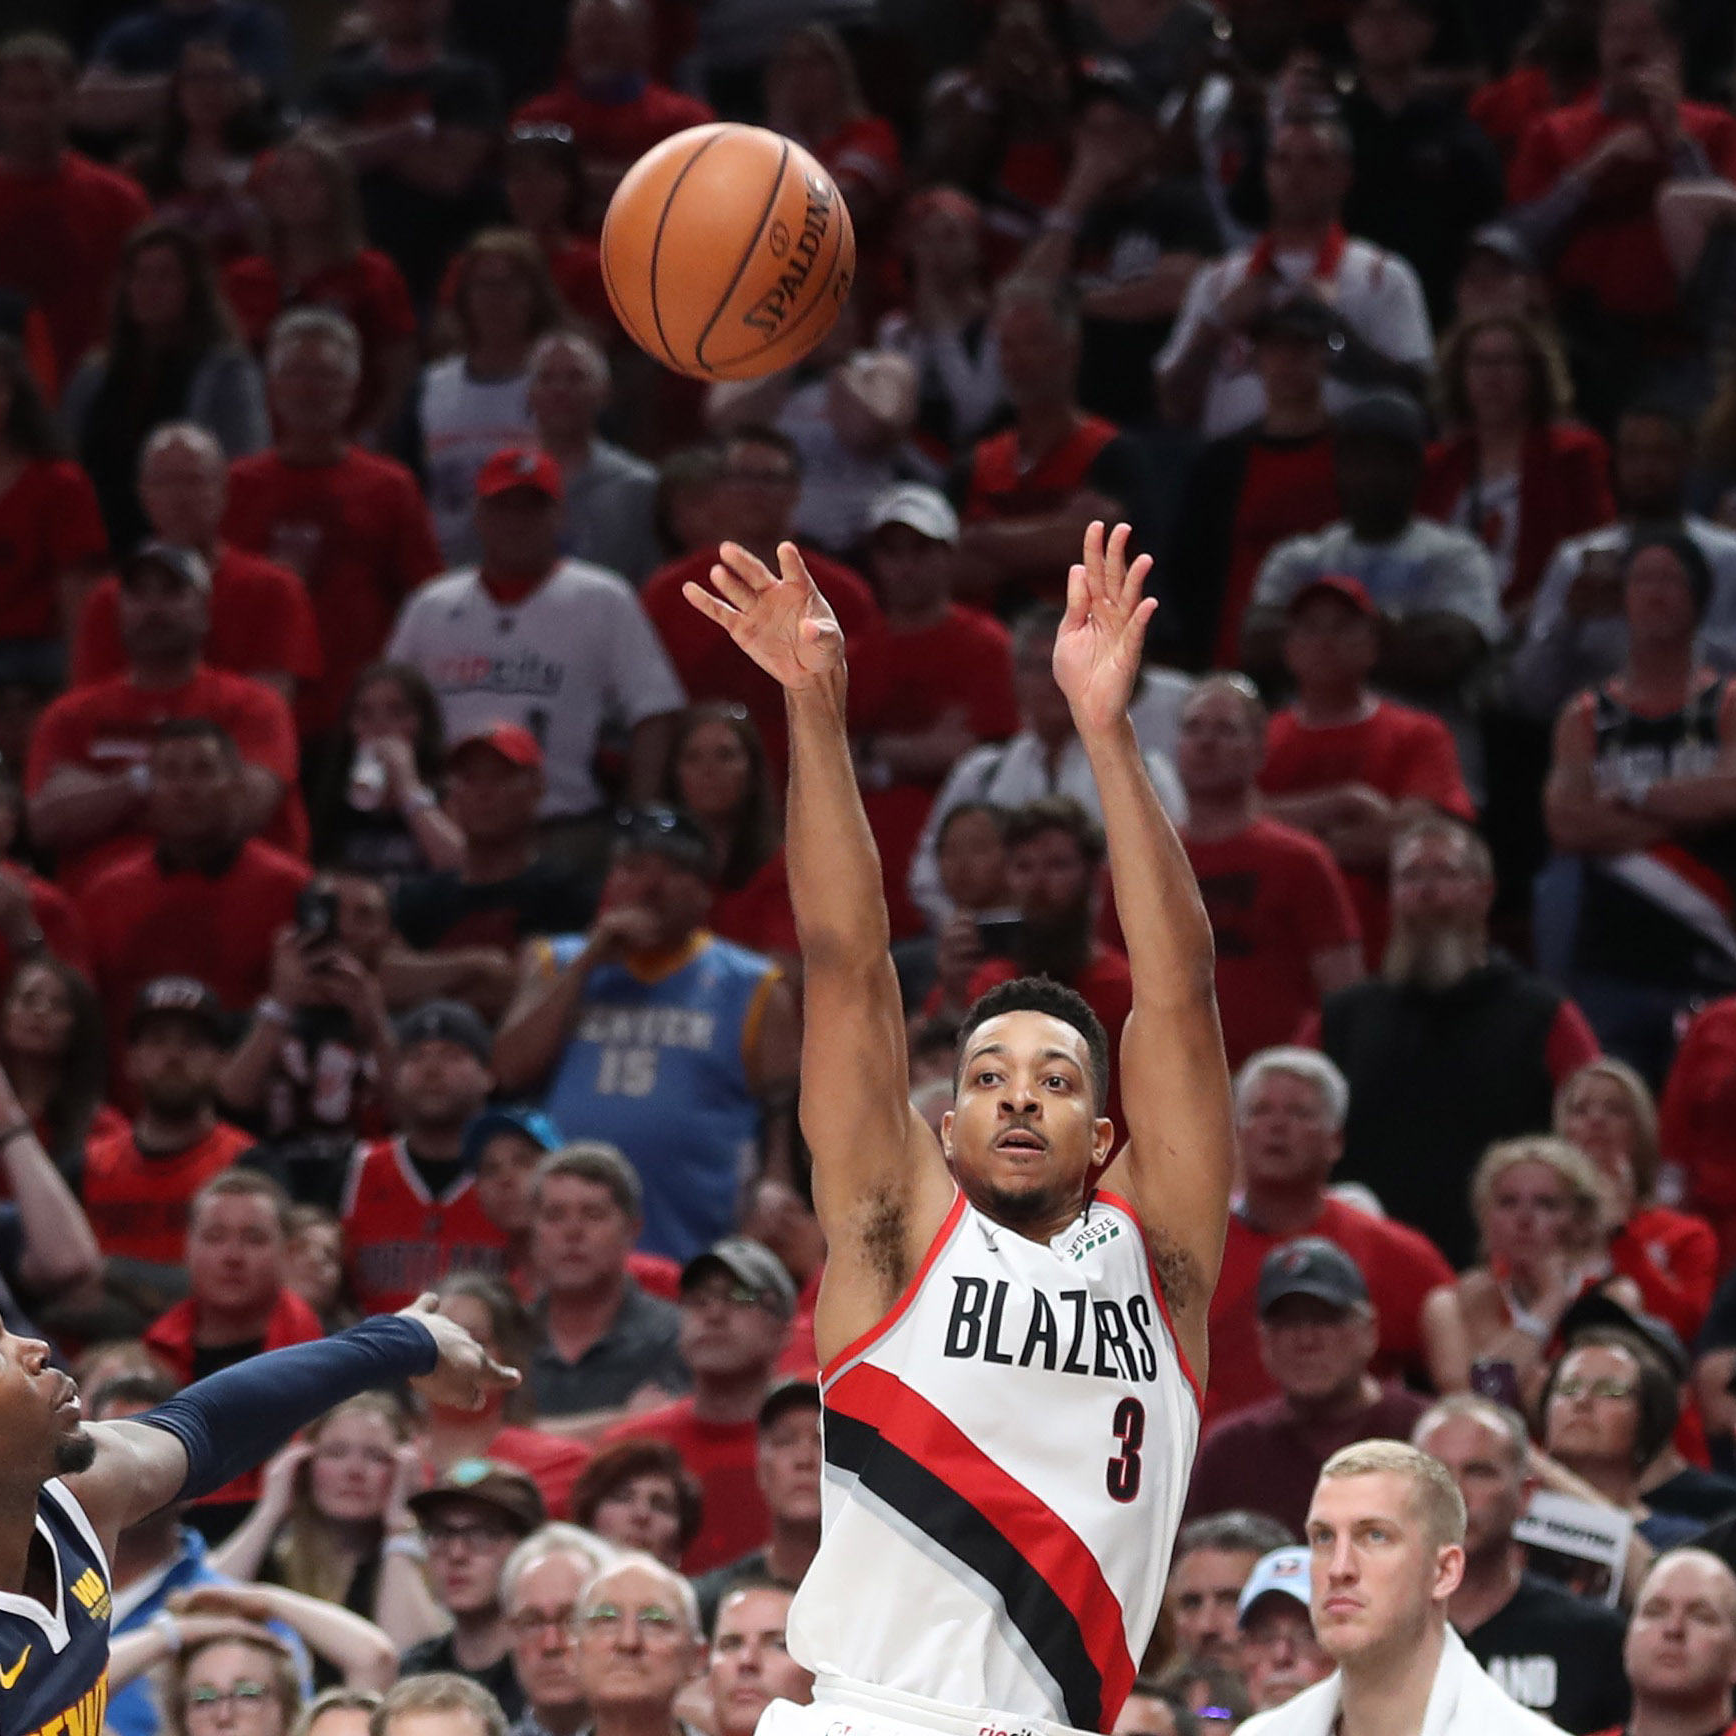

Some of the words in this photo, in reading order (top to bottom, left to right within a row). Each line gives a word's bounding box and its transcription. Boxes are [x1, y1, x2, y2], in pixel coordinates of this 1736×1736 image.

[742, 173, 832, 335] SPALDING
[944, 1276, 1158, 1382] BLAZERS
[1106, 1396, 1146, 1504] 3
